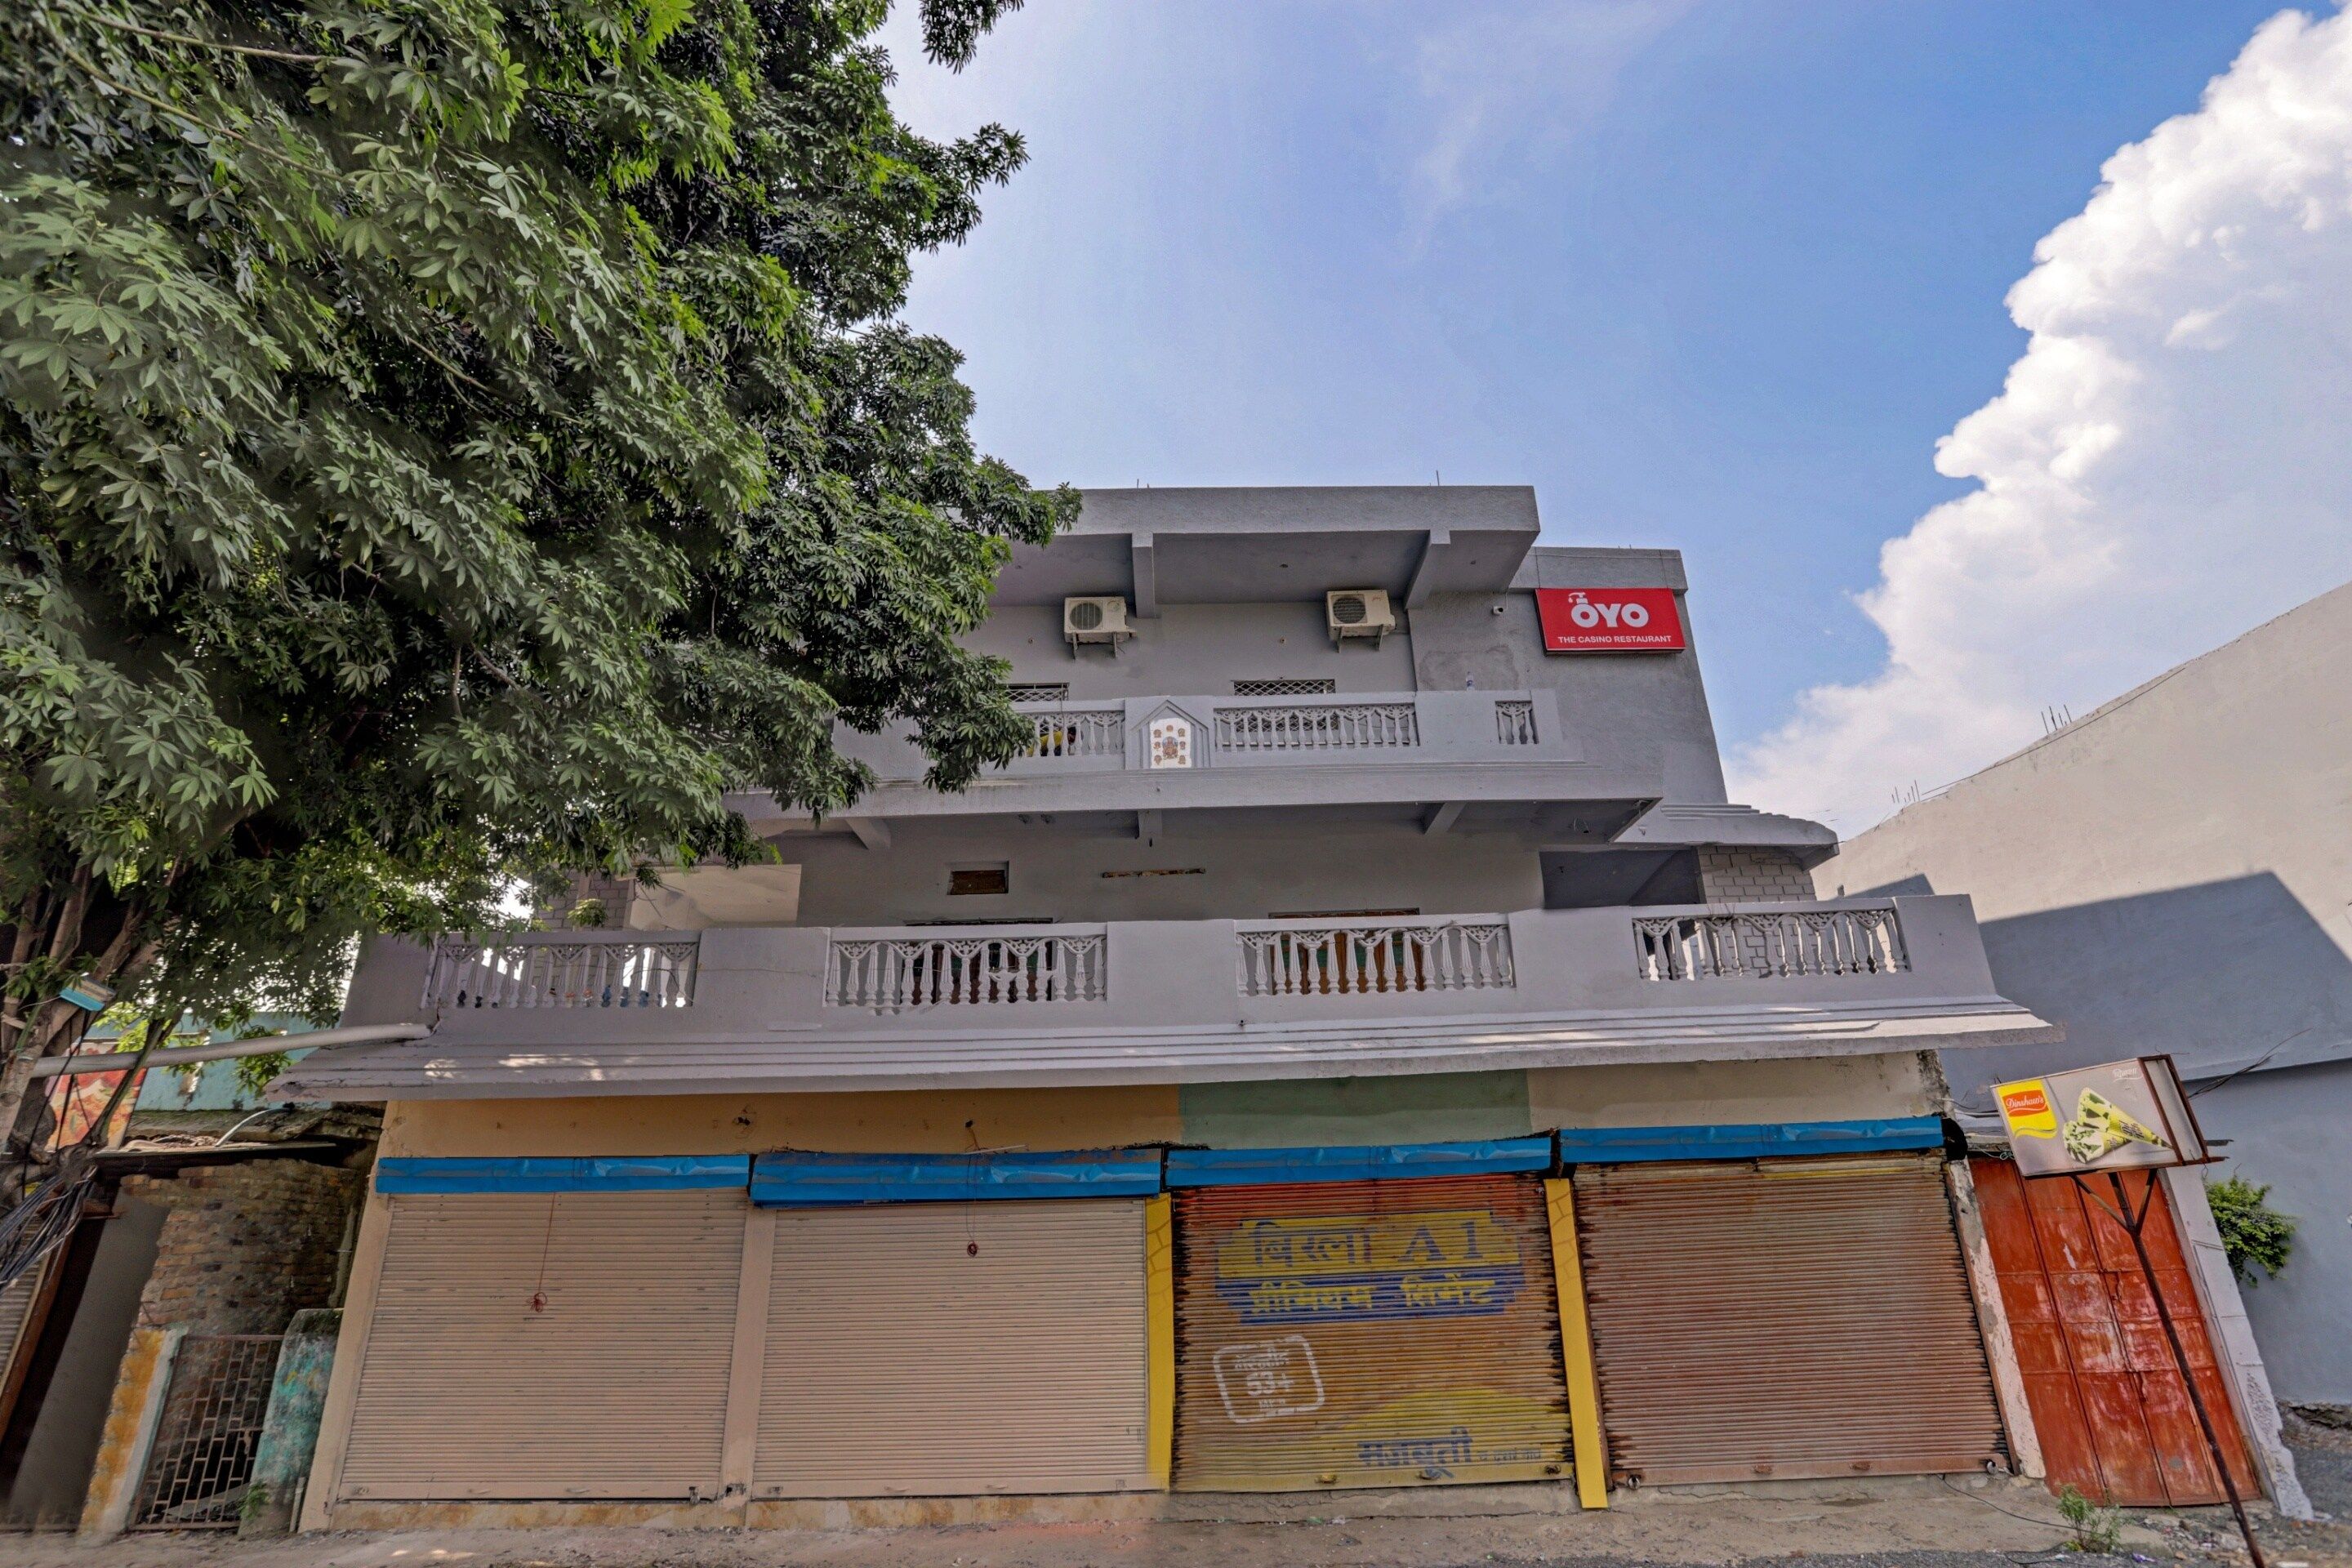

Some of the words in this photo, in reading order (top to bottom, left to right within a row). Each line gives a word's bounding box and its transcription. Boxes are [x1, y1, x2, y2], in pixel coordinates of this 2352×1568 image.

[1570, 603, 1649, 628] OYO
[1578, 635, 1612, 644] CASINO
[1614, 635, 1672, 643] RESTAURANT
[2006, 1094, 2044, 1109] Dinshaw's
